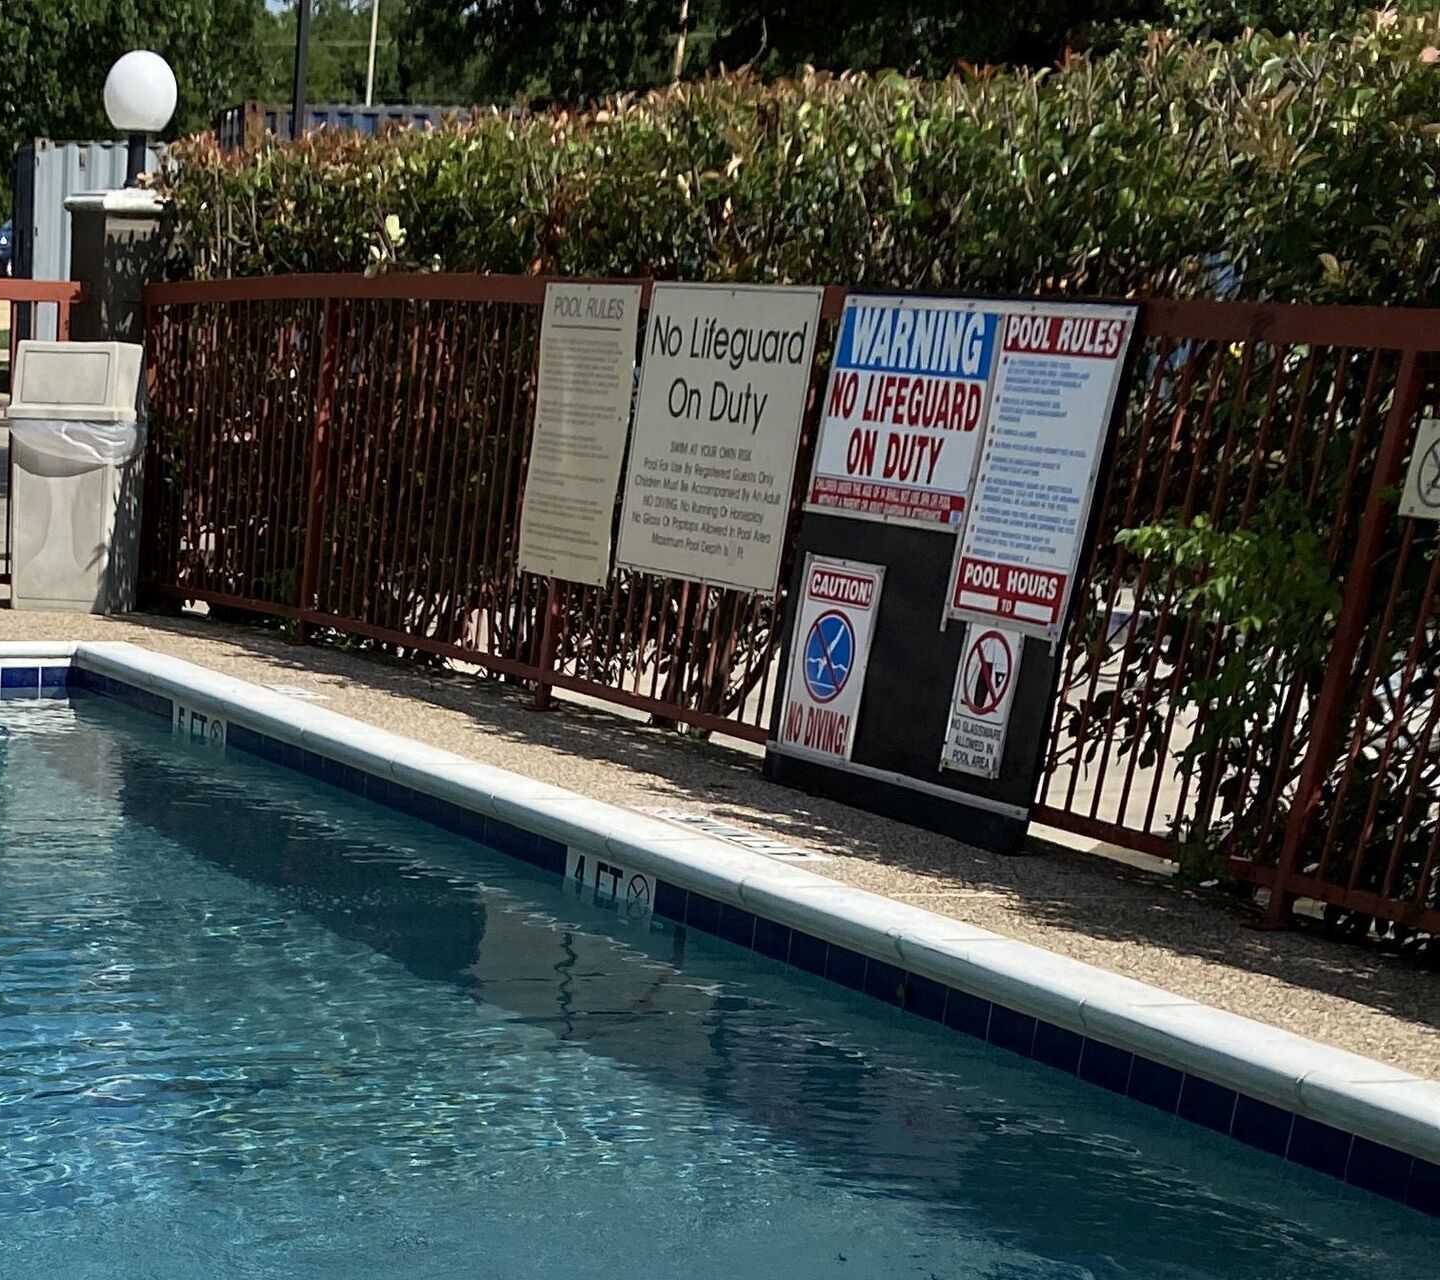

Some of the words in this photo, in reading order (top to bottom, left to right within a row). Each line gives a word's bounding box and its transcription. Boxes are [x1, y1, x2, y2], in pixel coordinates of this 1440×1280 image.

[554, 296, 582, 318] POOL
[586, 297, 624, 320] RULES
[651, 315, 682, 357] No
[690, 316, 808, 370] Lifeguard
[850, 306, 985, 376] WARNING
[1006, 315, 1052, 350] POOL
[1057, 318, 1121, 355] RULES
[668, 377, 702, 420] On
[709, 381, 768, 434] Duty
[828, 371, 859, 420] NO
[862, 374, 982, 433] LIFEGUARD
[701, 444, 717, 457] YOUR
[846, 427, 878, 477] ON
[883, 433, 945, 485] DUTY
[644, 457, 657, 470] Pool
[758, 471, 775, 488] Only
[811, 574, 873, 601] CAUTION!
[963, 562, 1001, 590] POOL
[1006, 570, 1058, 600] HOURS
[1001, 598, 1012, 613] TO
[785, 701, 804, 743] NO
[804, 708, 850, 756] DIVING!
[955, 735, 984, 753] ALLOWED
[986, 743, 994, 756] IN
[952, 749, 969, 766] POOL
[970, 755, 989, 769] AREA
